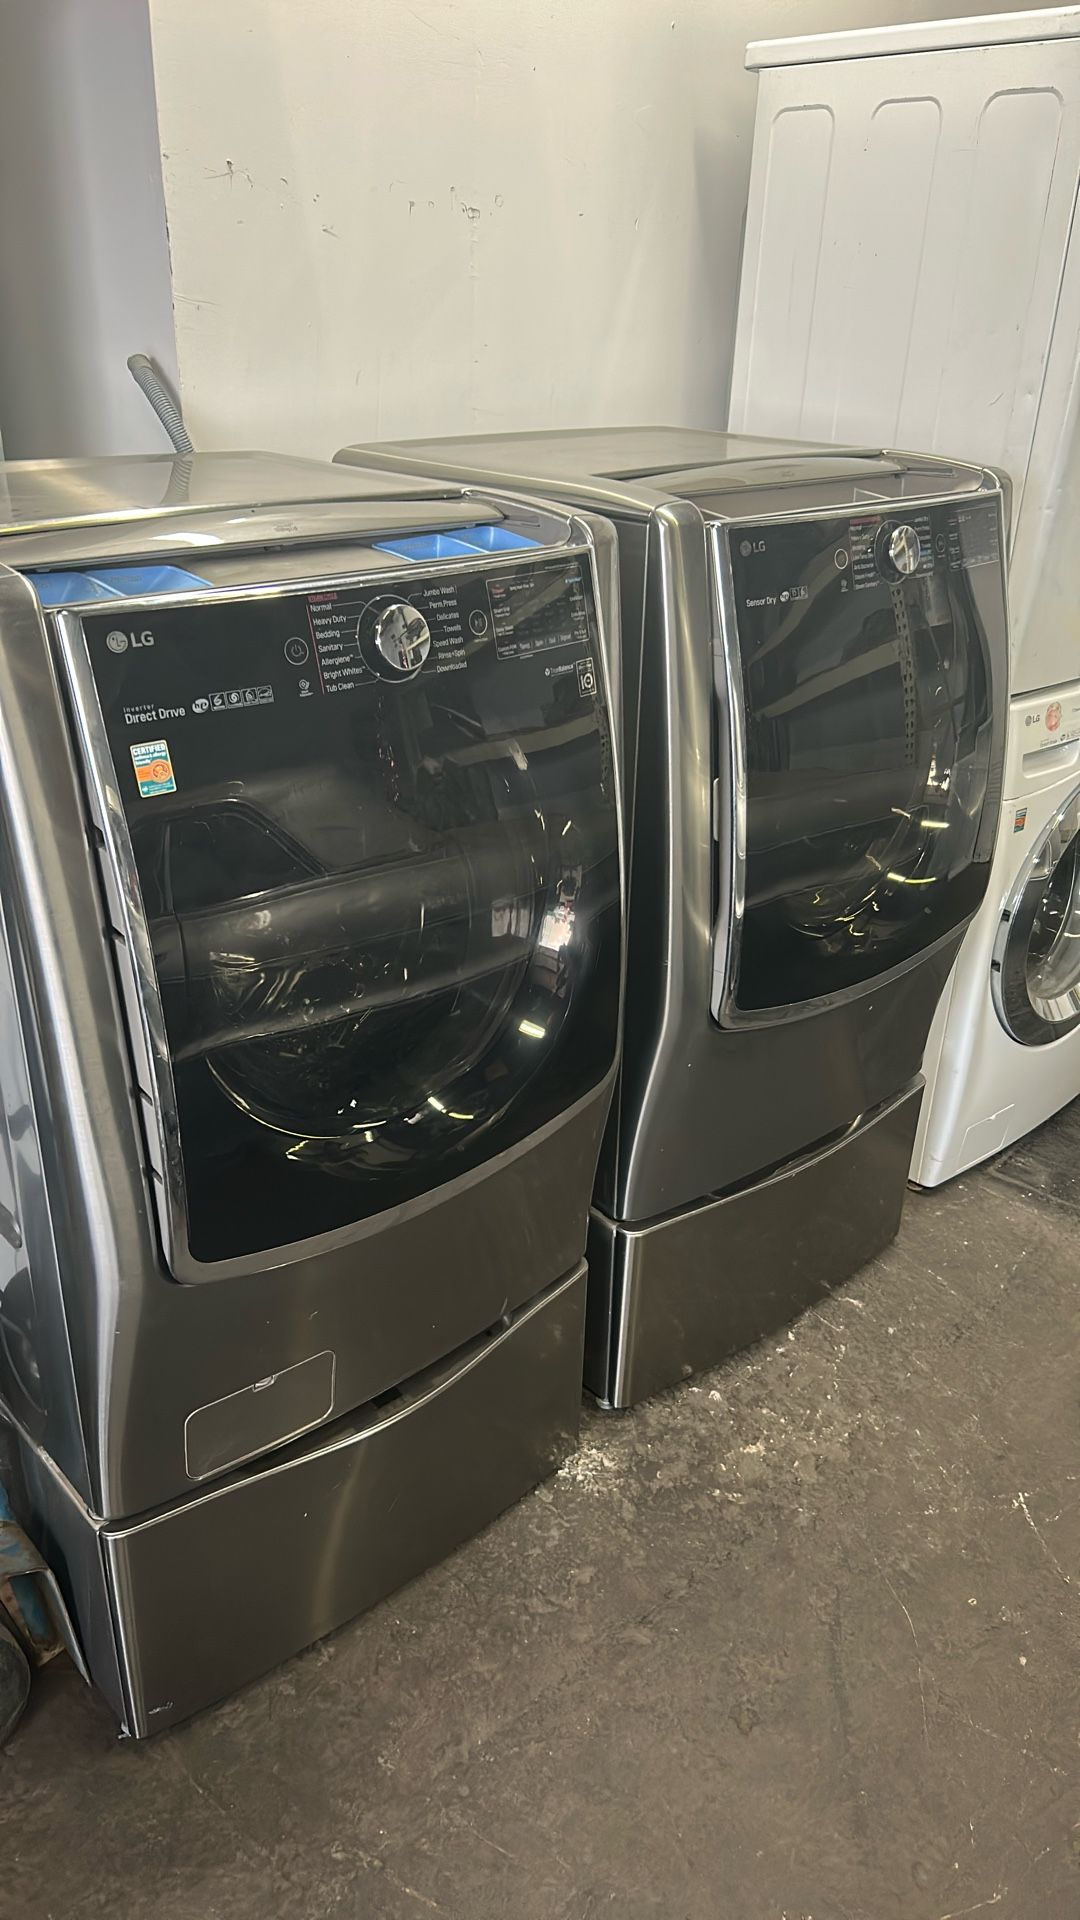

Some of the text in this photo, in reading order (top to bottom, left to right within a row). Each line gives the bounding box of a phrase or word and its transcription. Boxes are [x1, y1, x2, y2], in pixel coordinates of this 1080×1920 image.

[753, 540, 766, 552] LG
[423, 586, 455, 597] Jumbo Wash
[746, 596, 777, 607] Sensor Dry
[310, 603, 332, 612] Normal
[313, 615, 347, 626] Heavy Duty
[436, 612, 460, 621] Delicates
[443, 624, 462, 633] Towels
[130, 631, 154, 648] LG
[315, 630, 340, 640] Bedding
[318, 643, 343, 653] Sanitary
[433, 639, 449, 649] Speed
[449, 636, 464, 646] Wash
[436, 660, 468, 673] Downloaded
[323, 671, 341, 680] Bright
[326, 681, 355, 693] Tub Clean
[123, 703, 154, 713] Inverter
[125, 706, 186, 725] Direct Drive
[1033, 714, 1040, 724] LG
[132, 743, 166, 755] CERTIFIED
